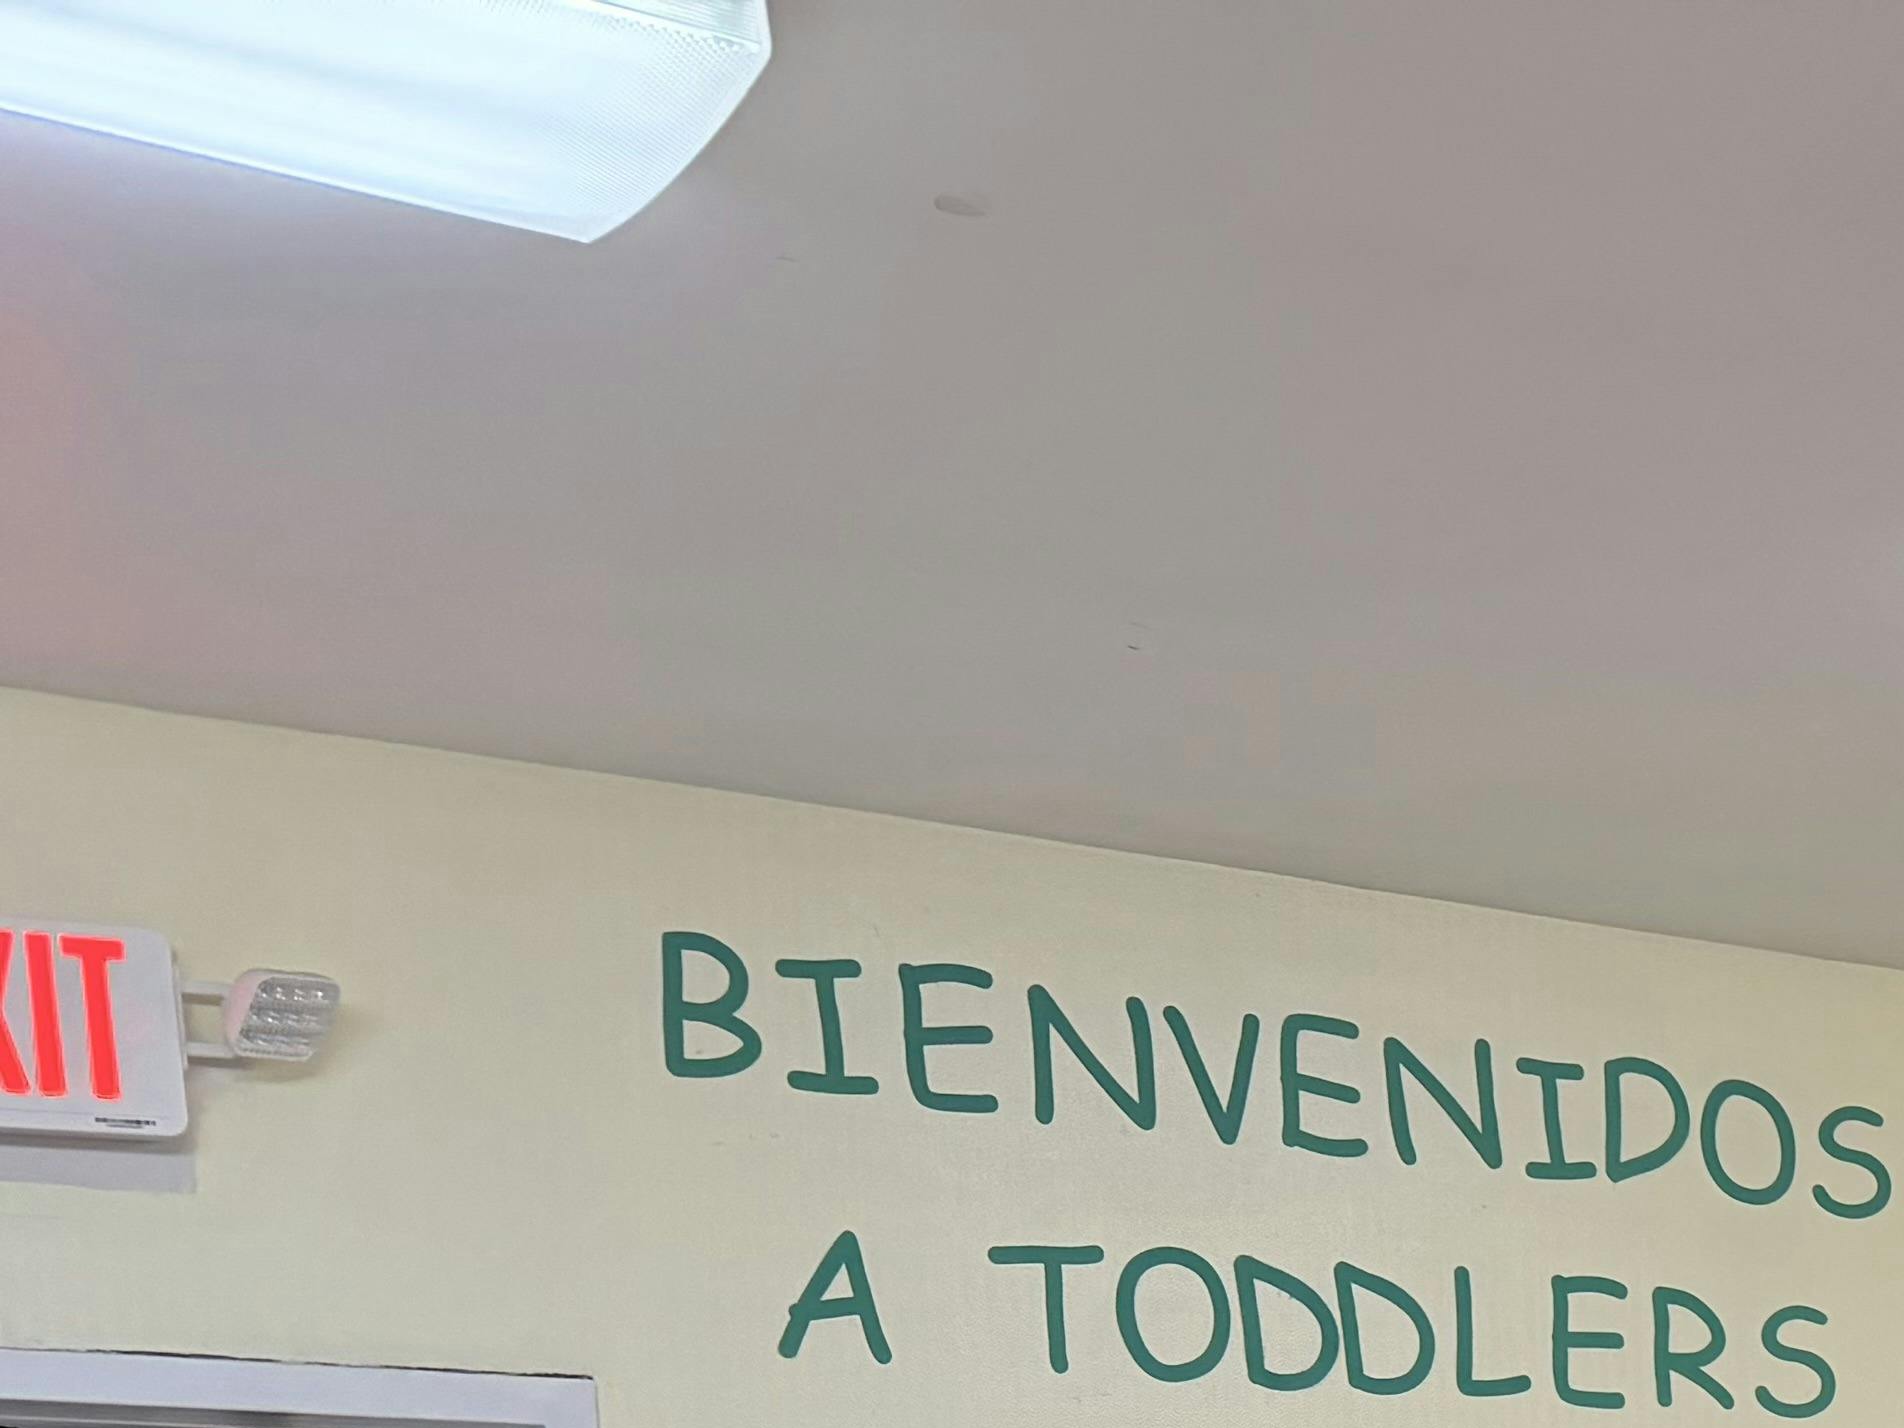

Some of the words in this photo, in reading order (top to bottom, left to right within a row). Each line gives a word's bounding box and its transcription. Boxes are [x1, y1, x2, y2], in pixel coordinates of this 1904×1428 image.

[663, 931, 1893, 1220] BIENVENIDOS
[778, 1229, 892, 1366] A
[988, 1244, 1838, 1420] TODDLERS
